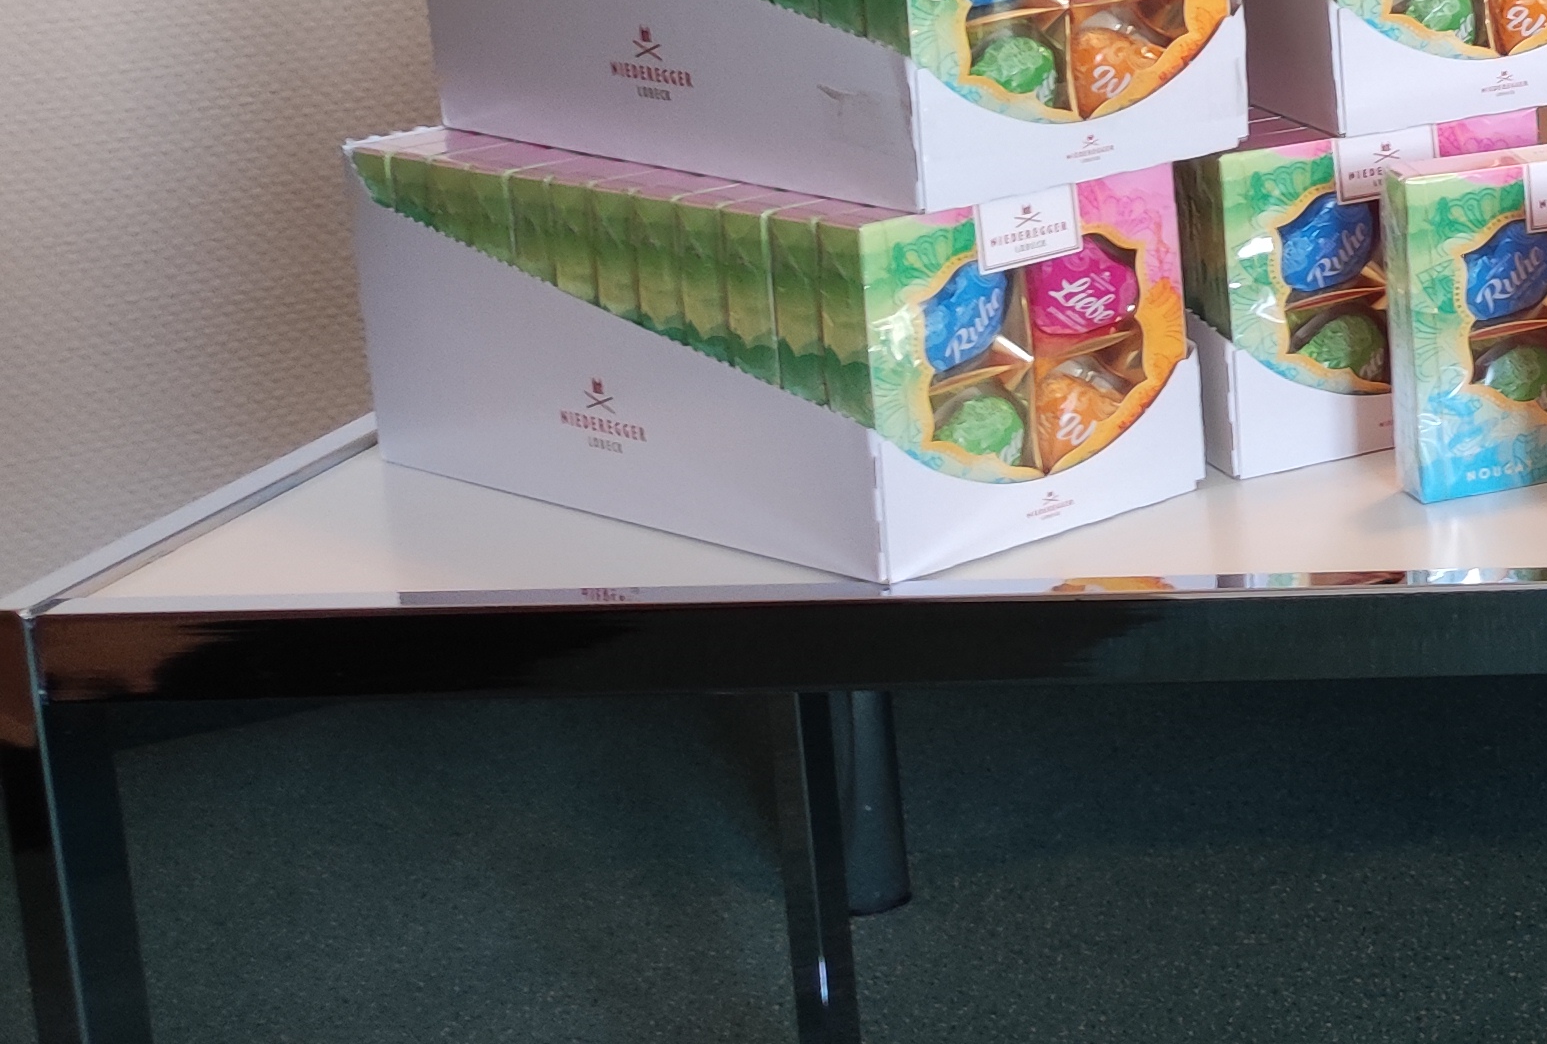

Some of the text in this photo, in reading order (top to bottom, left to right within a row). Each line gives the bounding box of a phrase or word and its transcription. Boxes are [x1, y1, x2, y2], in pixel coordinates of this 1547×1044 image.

[610, 61, 694, 88] NIEDEREGGER
[991, 220, 1069, 247] NIEDEREGGER
[1475, 245, 1543, 313] Ruhe
[1048, 277, 1116, 323] Liebe
[560, 408, 647, 443] NIEDEREGGER
[1465, 458, 1534, 482] NOUGAT
